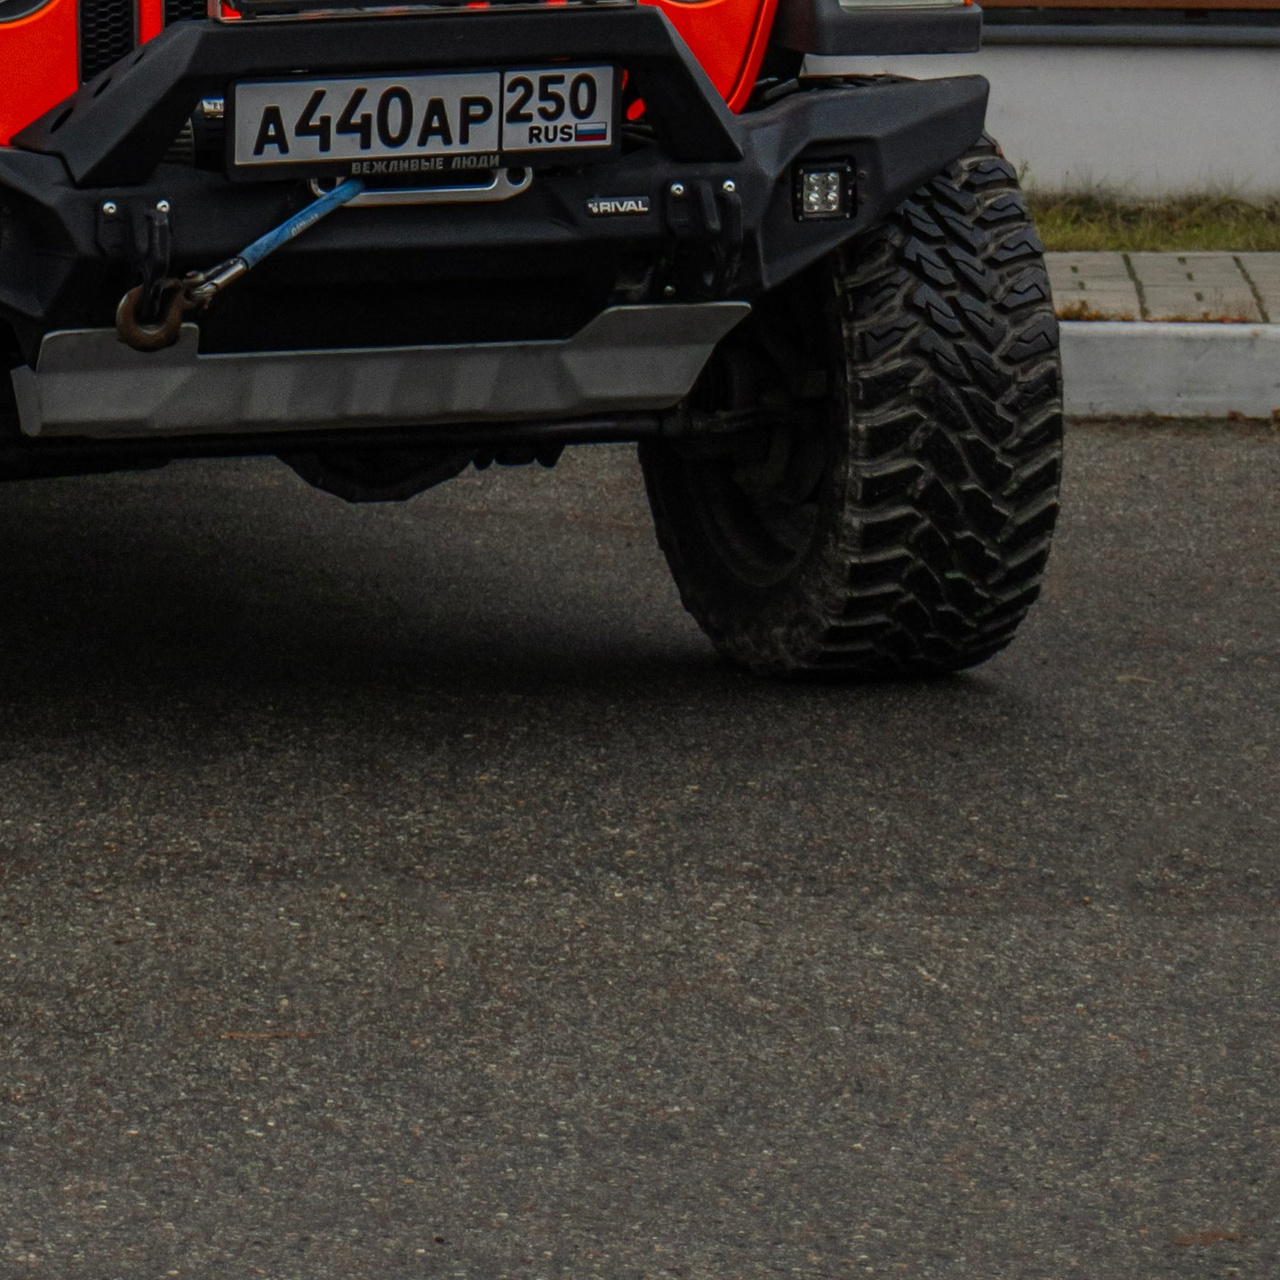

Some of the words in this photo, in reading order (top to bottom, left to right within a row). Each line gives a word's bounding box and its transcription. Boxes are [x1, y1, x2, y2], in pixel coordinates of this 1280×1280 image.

[504, 72, 597, 124] 250
[528, 124, 574, 144] RUS
[351, 157, 444, 175] ВЕЖЛИВЫЕ
[451, 154, 500, 170] ЛЮДИ
[600, 200, 649, 213] RIVAL
